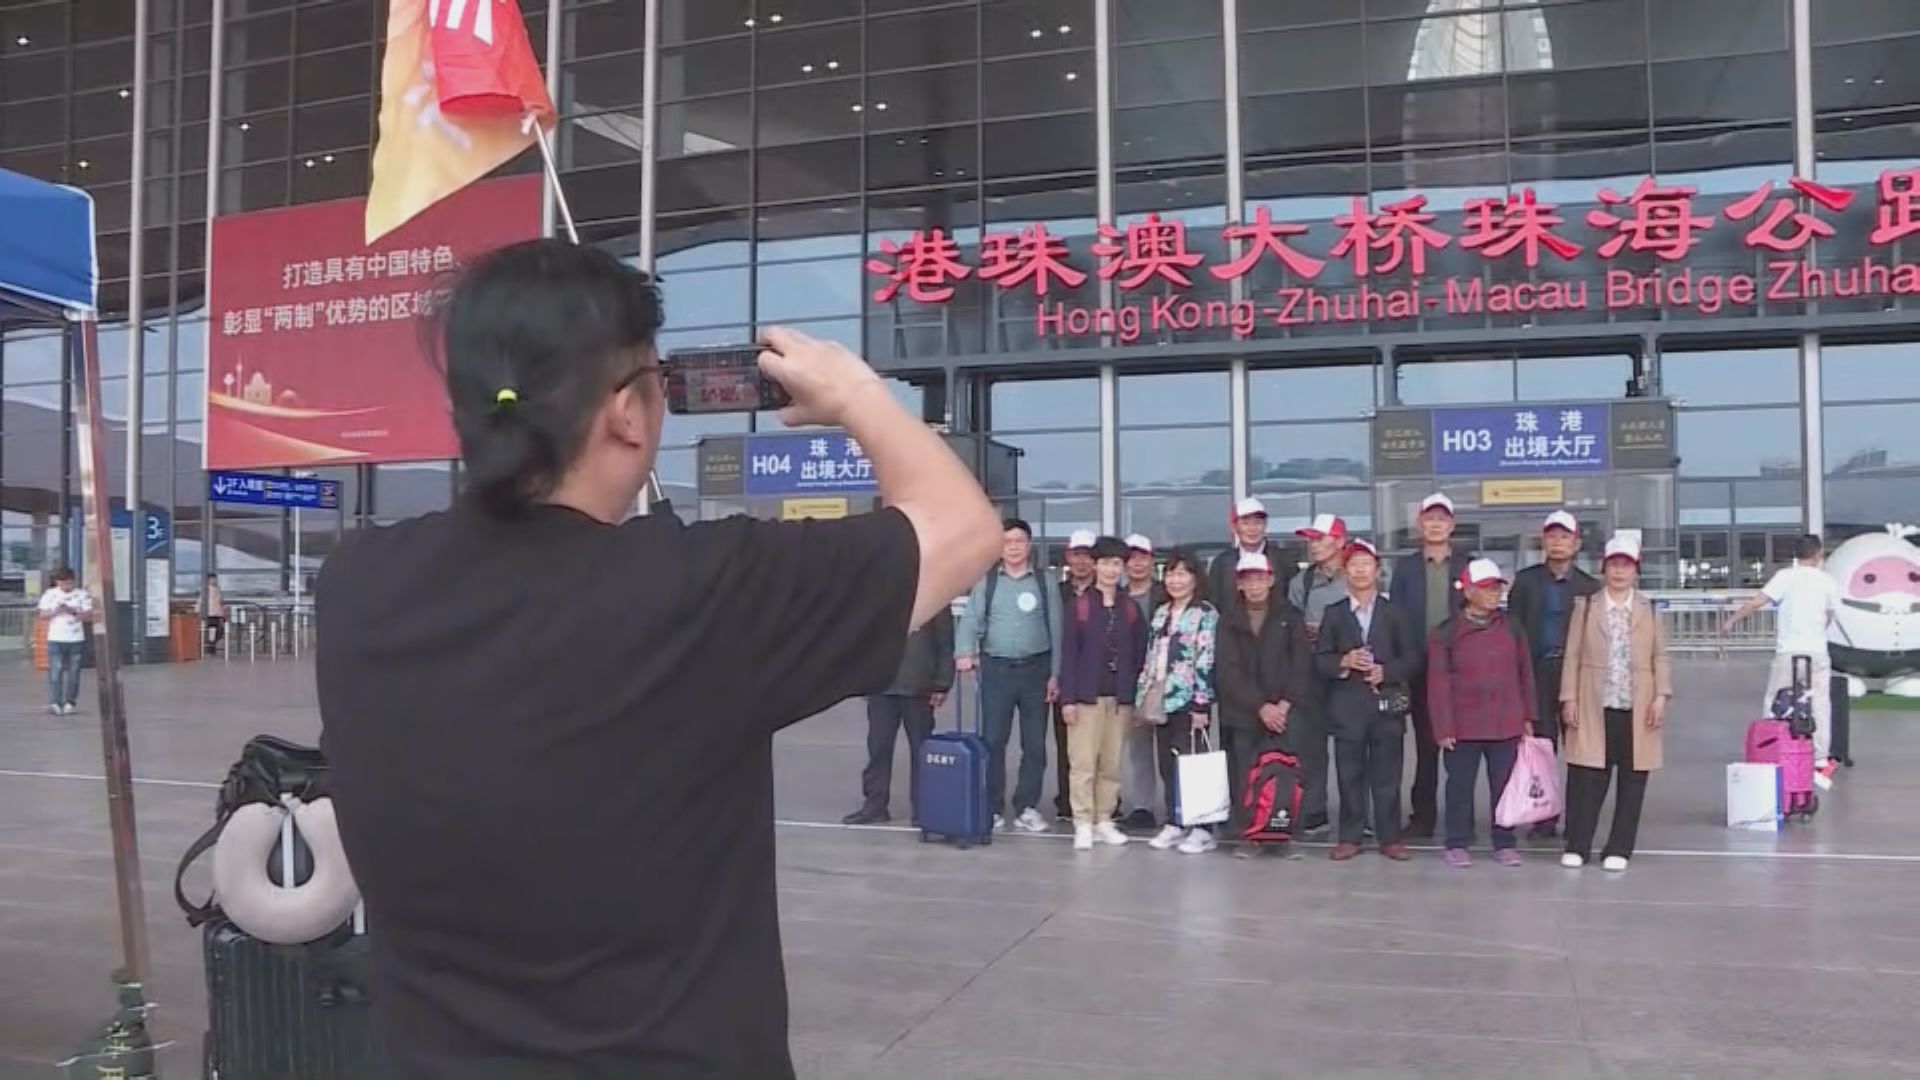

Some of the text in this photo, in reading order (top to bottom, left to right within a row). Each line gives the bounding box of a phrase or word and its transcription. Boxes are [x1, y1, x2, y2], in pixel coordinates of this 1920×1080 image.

[1037, 302, 1140, 342] Hong
[1606, 267, 1755, 314] Bridge
[1442, 429, 1492, 452] H03
[1504, 434, 1596, 458] 出境大厅
[752, 453, 792, 476] H04
[801, 458, 873, 480] 出境大厅
